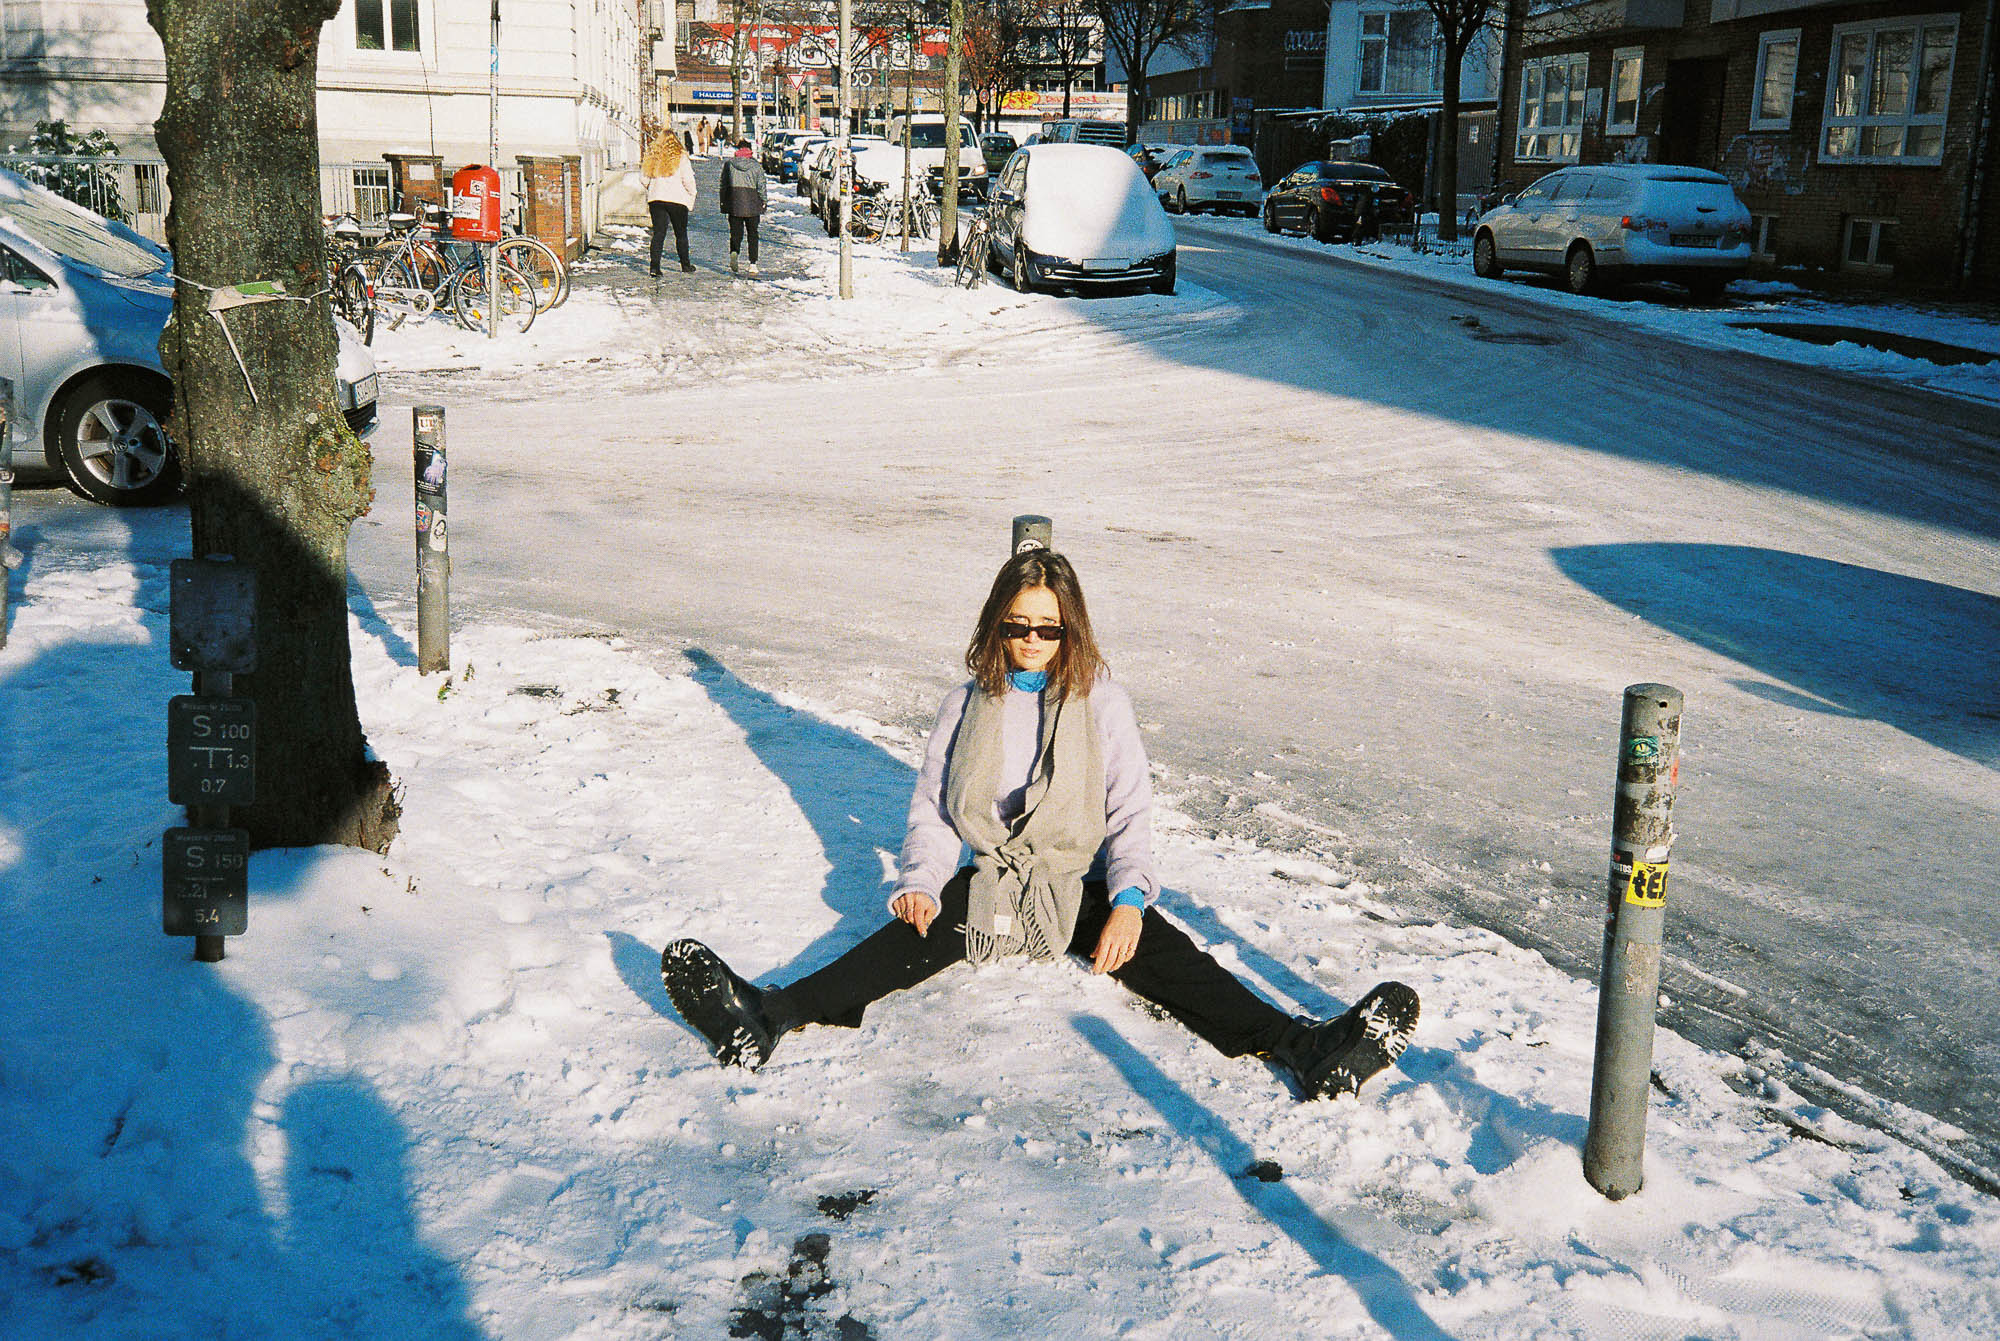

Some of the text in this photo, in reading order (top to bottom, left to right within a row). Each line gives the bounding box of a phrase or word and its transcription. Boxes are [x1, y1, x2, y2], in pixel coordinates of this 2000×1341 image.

[192, 714, 249, 740] S 100
[186, 845, 205, 868] S
[194, 908, 220, 923] 5.4
